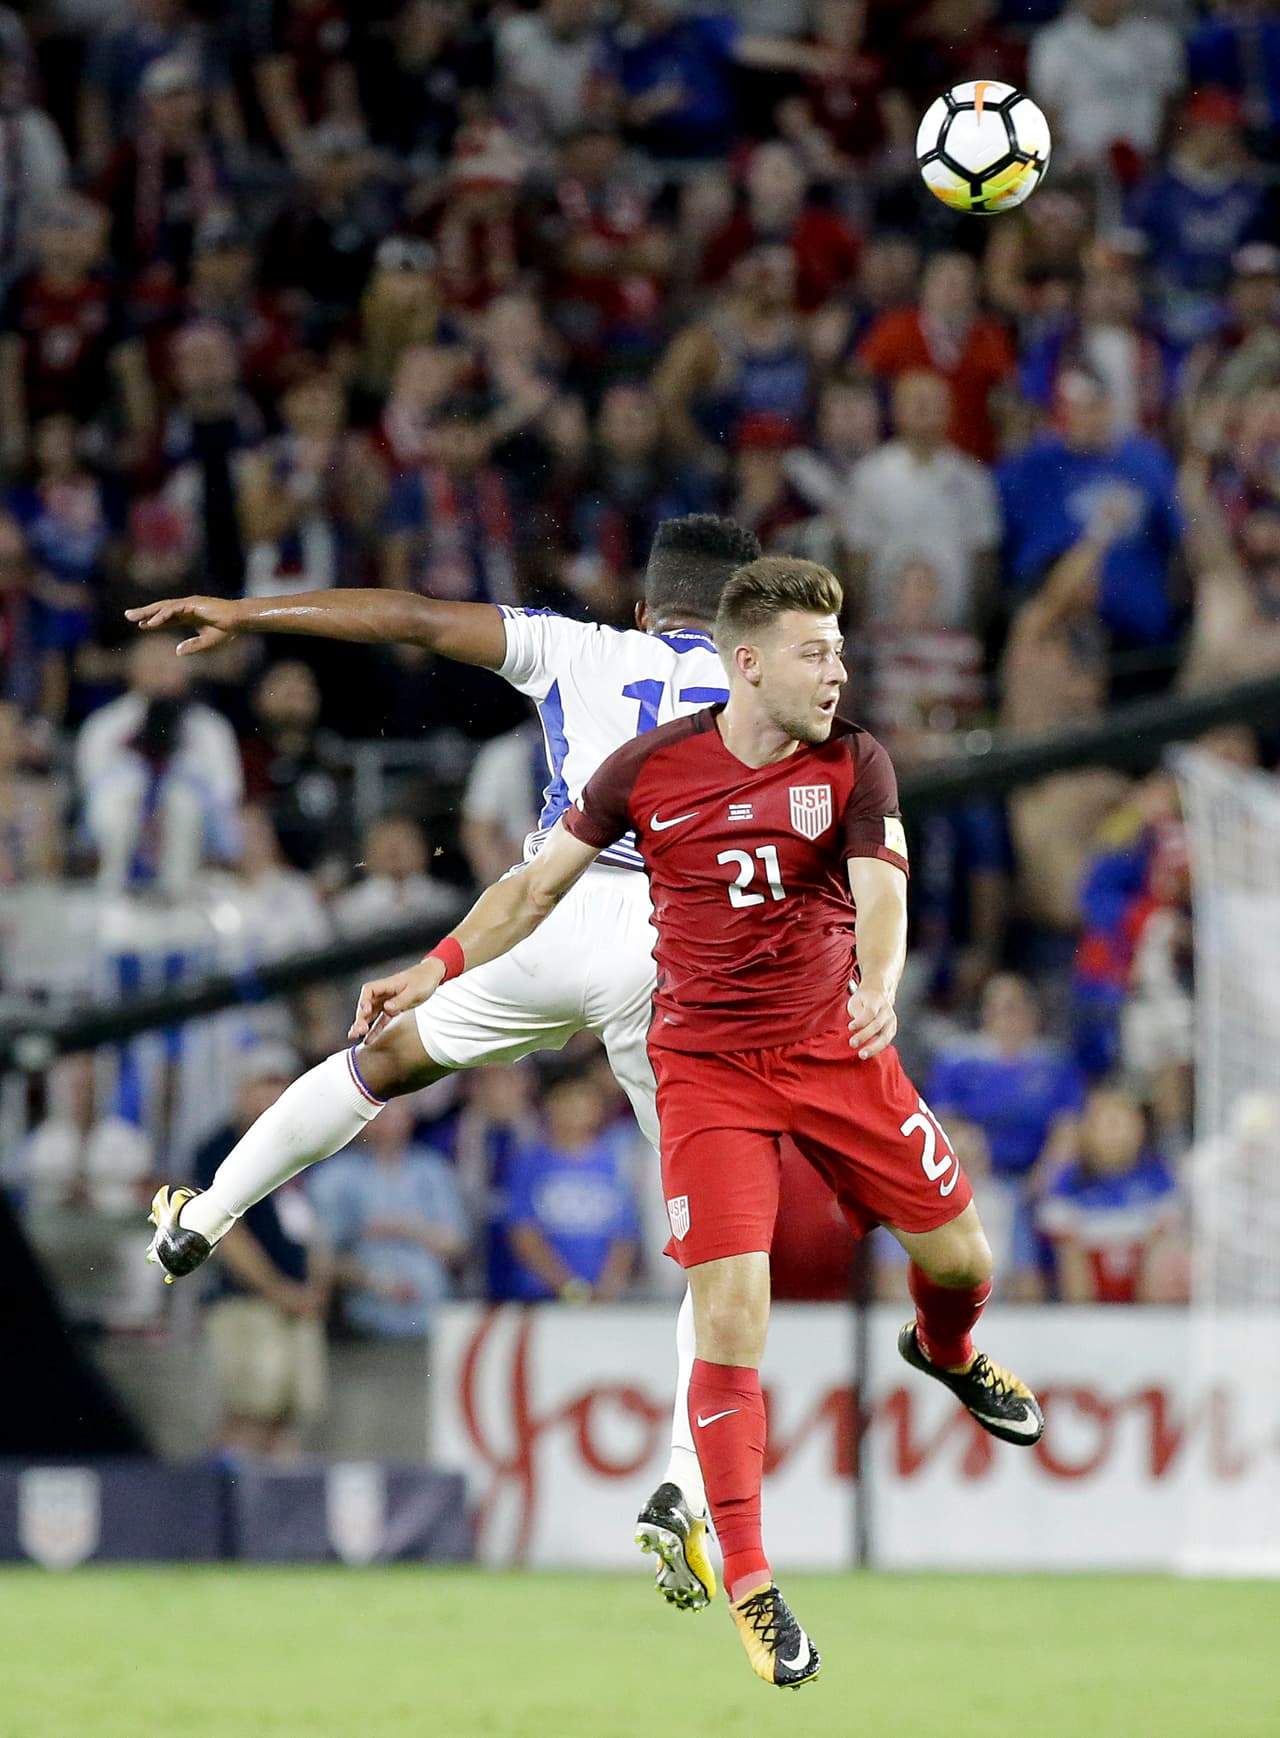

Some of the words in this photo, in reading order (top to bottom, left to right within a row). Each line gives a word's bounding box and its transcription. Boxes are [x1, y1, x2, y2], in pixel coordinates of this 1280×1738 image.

[793, 788, 827, 809] USA
[716, 845, 787, 908] 21
[459, 1302, 1250, 1560] Jonson
